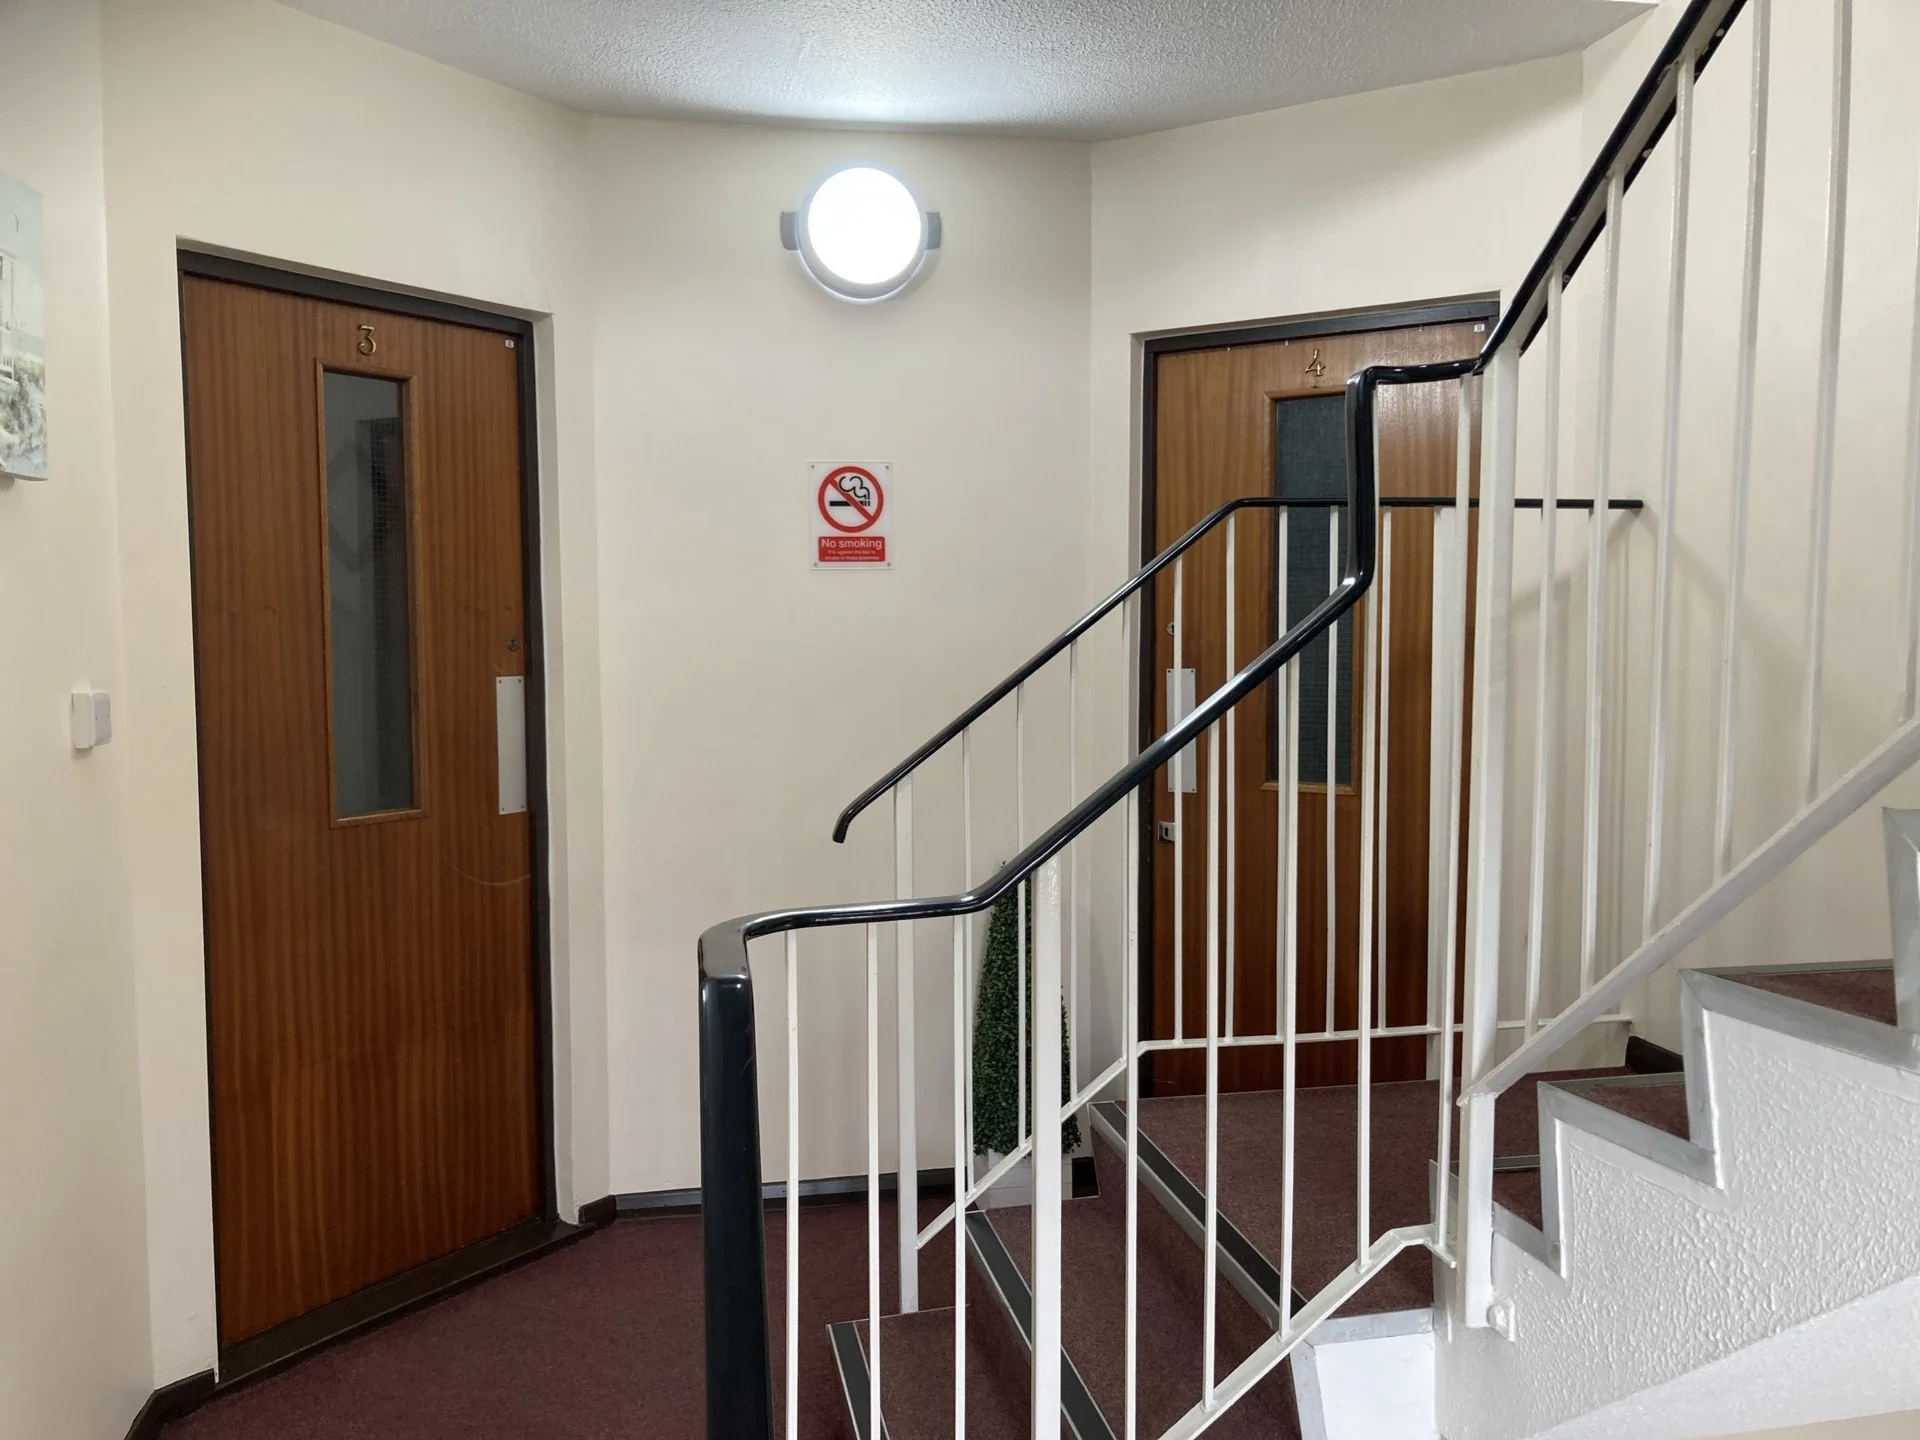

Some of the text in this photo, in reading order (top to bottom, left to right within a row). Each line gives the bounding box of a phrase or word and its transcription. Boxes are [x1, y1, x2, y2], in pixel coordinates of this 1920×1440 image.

[357, 324, 377, 357] 3
[1305, 349, 1326, 377] 4
[821, 538, 882, 551] No smoking
